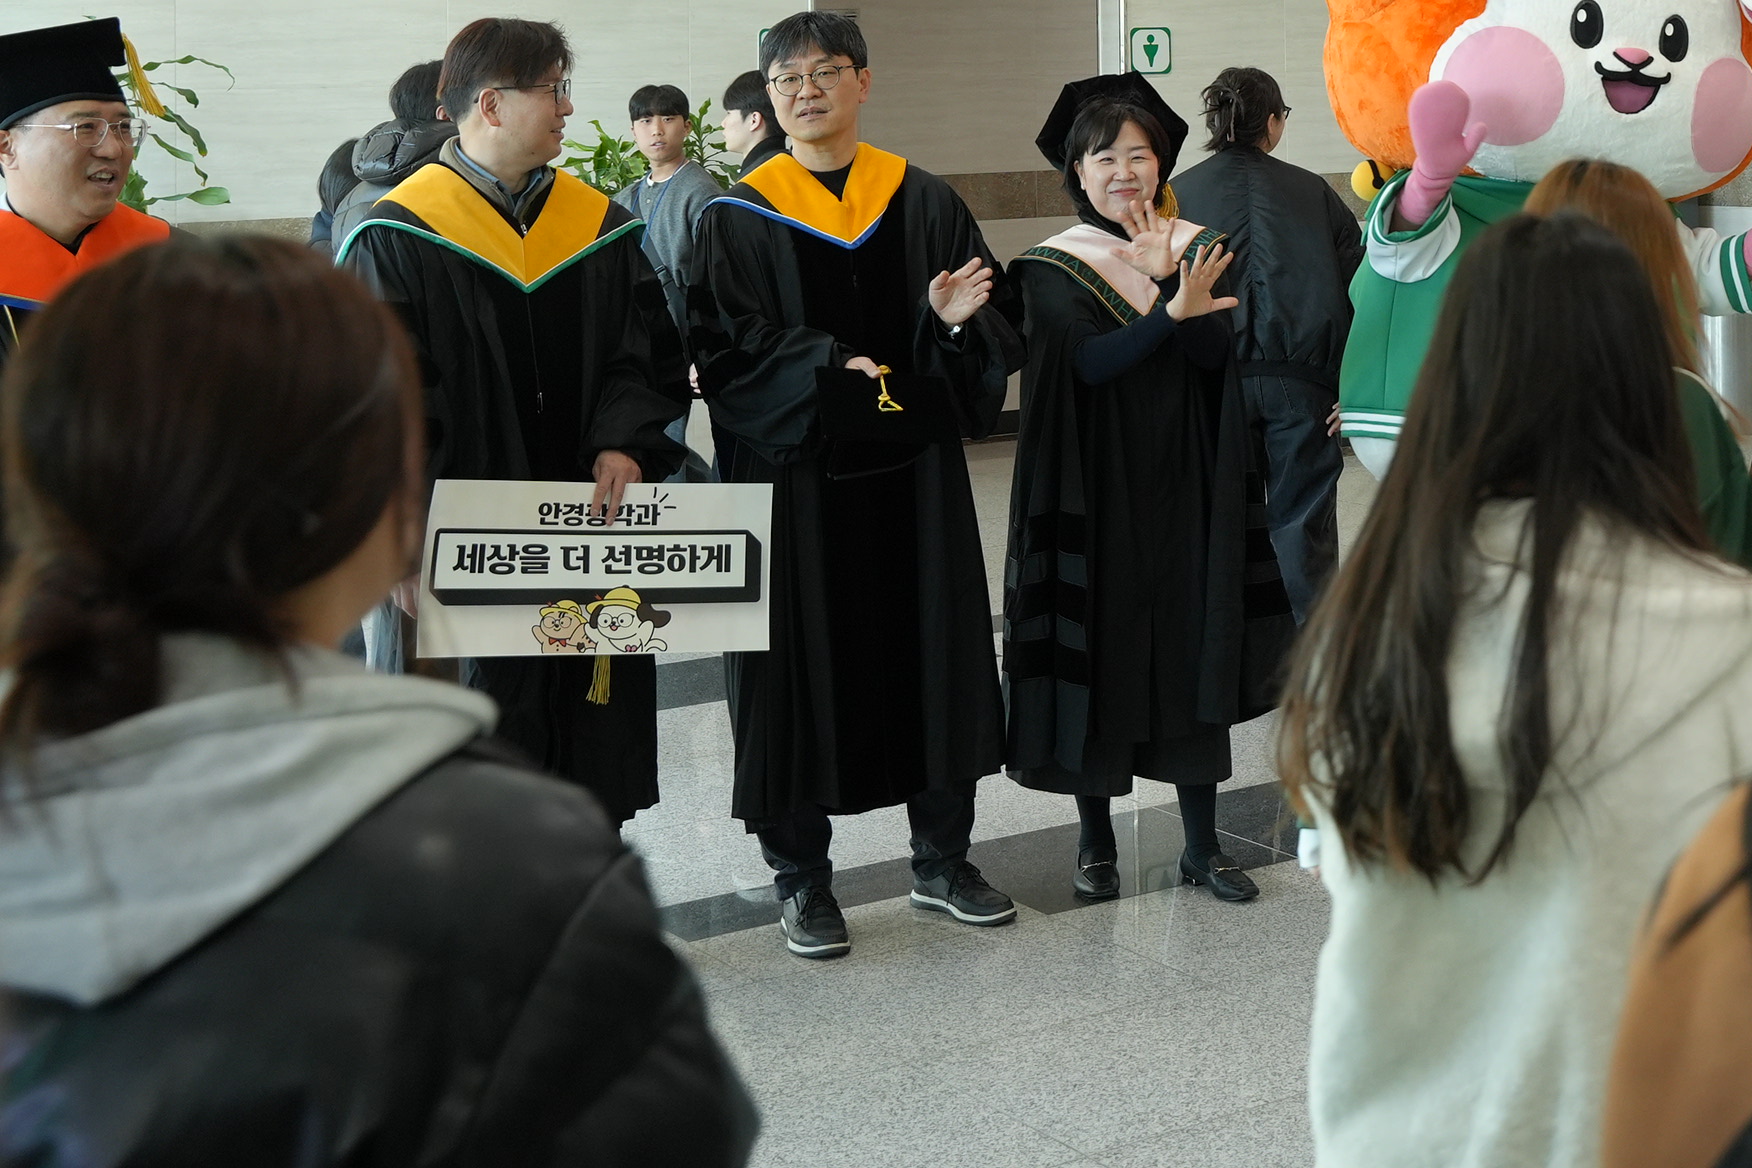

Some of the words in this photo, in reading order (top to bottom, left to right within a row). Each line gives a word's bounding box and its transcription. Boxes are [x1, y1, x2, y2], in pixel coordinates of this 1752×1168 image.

[1093, 278, 1142, 323] EWH
[452, 542, 550, 575] 세상을
[560, 544, 591, 574] 더
[601, 543, 732, 575] 선명하게
